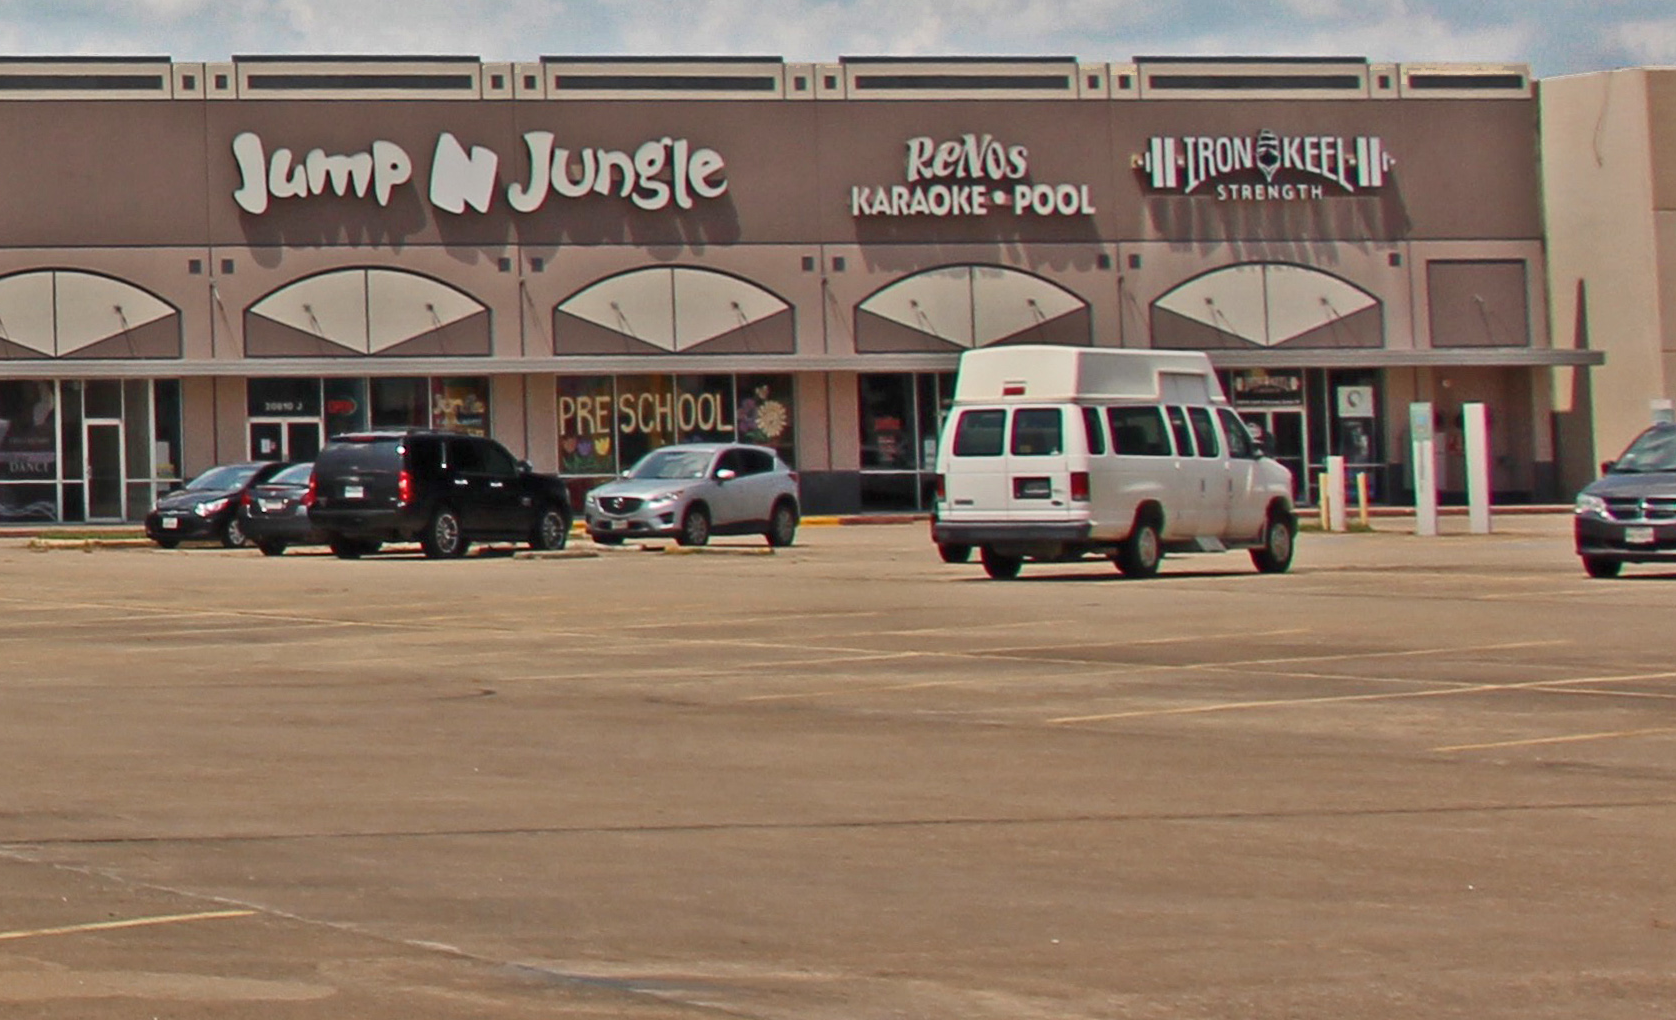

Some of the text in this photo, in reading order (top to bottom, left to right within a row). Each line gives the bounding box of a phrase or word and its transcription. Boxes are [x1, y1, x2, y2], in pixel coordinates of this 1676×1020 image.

[232, 131, 728, 214] Jump N Jungle
[1183, 136, 1354, 194] IRON KEEL
[851, 184, 1096, 217] KARAOKE POOL
[1217, 184, 1324, 201] STRENGTH
